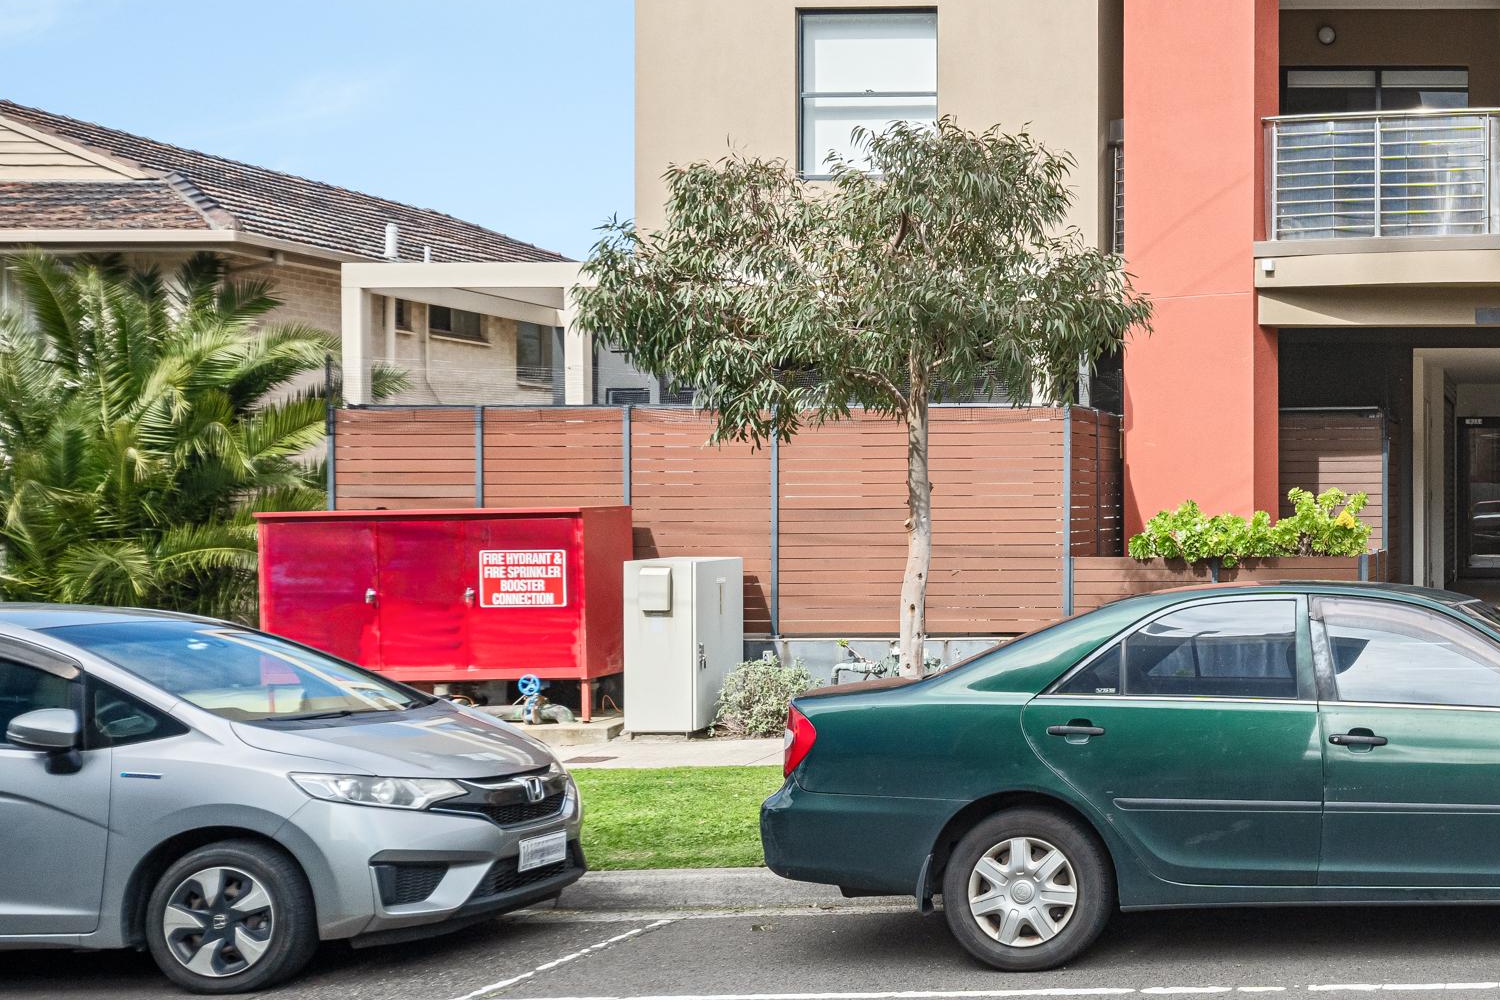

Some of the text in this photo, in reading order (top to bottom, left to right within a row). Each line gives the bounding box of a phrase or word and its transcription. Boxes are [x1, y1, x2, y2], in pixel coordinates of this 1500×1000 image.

[483, 552, 562, 564] FIRE HYDRANT &
[484, 566, 561, 578] FIRE SPRINKLER
[500, 579, 545, 592] BOOSTER
[492, 592, 554, 605] CONNECTION
